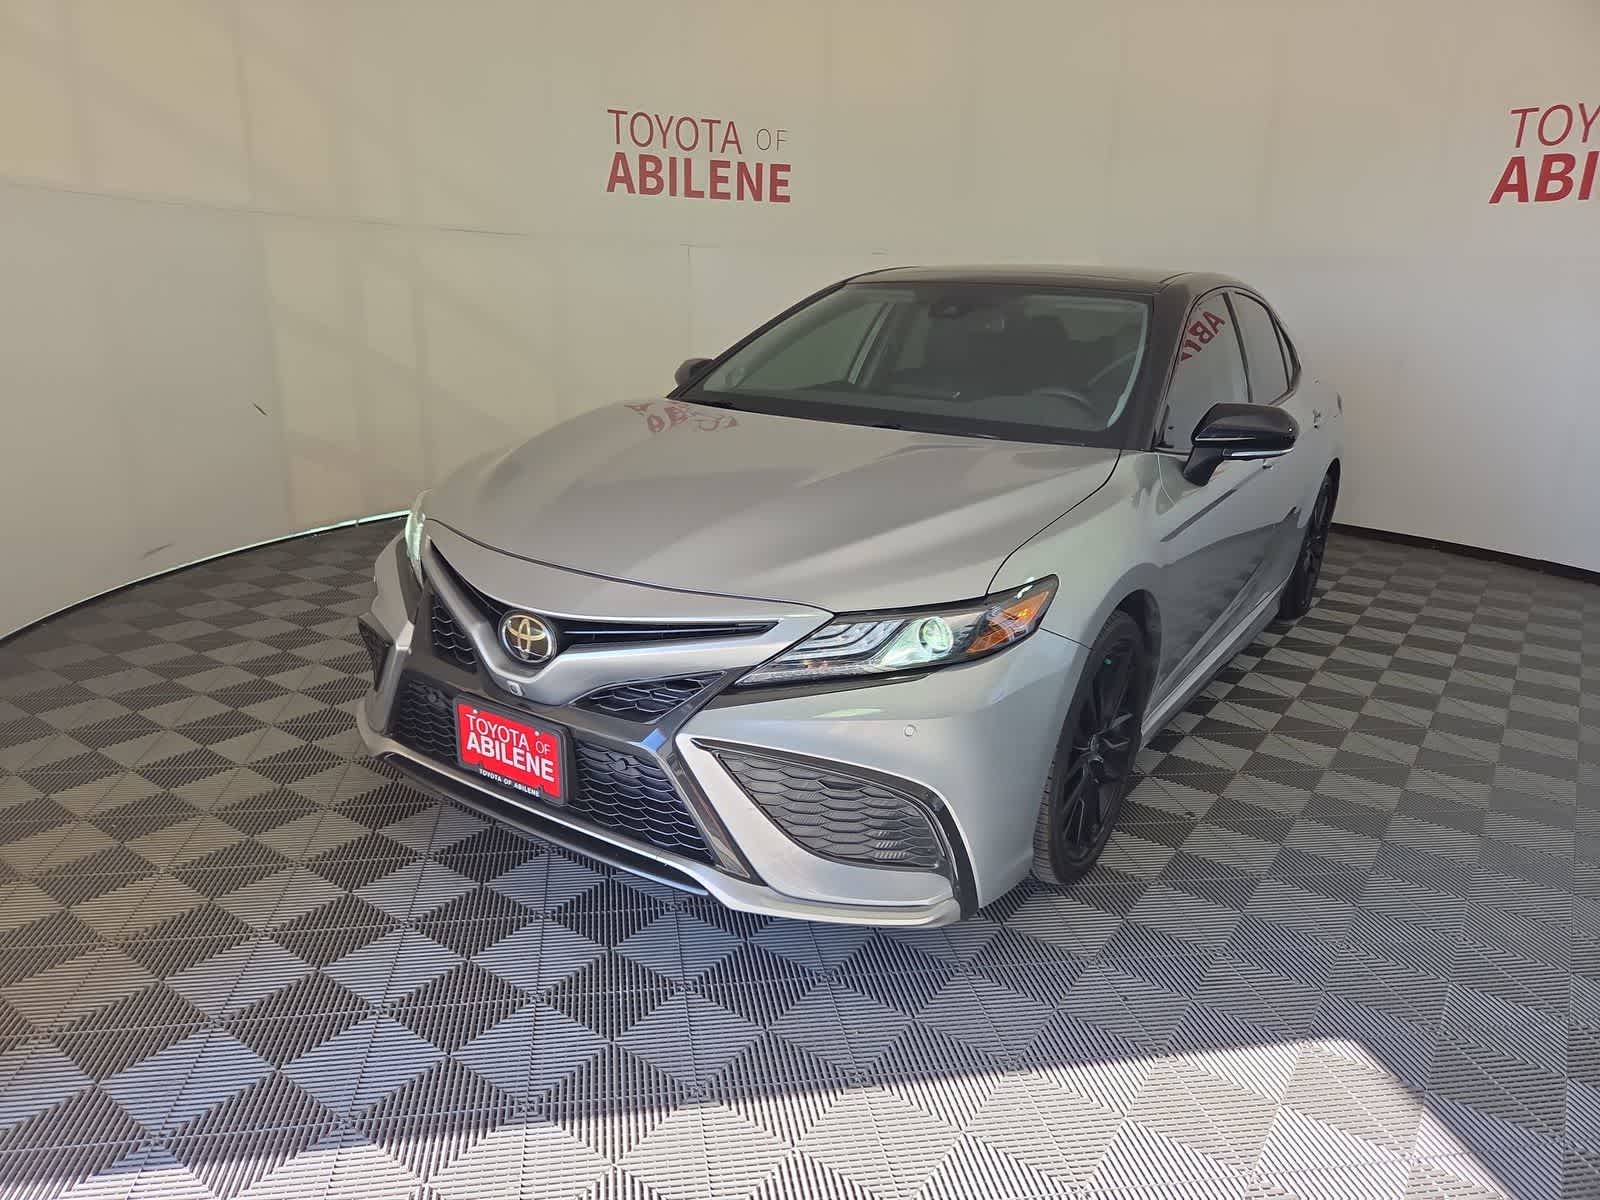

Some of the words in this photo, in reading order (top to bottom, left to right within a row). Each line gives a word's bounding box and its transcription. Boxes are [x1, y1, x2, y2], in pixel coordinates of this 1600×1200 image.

[607, 109, 742, 154] TOYOTA
[756, 128, 788, 152] OF
[1511, 103, 1600, 148] TOY
[606, 151, 792, 203] ABILENE
[1488, 151, 1600, 204] ABI
[465, 714, 530, 751] TOYOTA
[535, 741, 551, 755] OF
[466, 732, 555, 783] ABILENE
[478, 768, 502, 782] TOYOTA
[503, 778, 513, 786] OF
[513, 782, 541, 797] ABILENE
